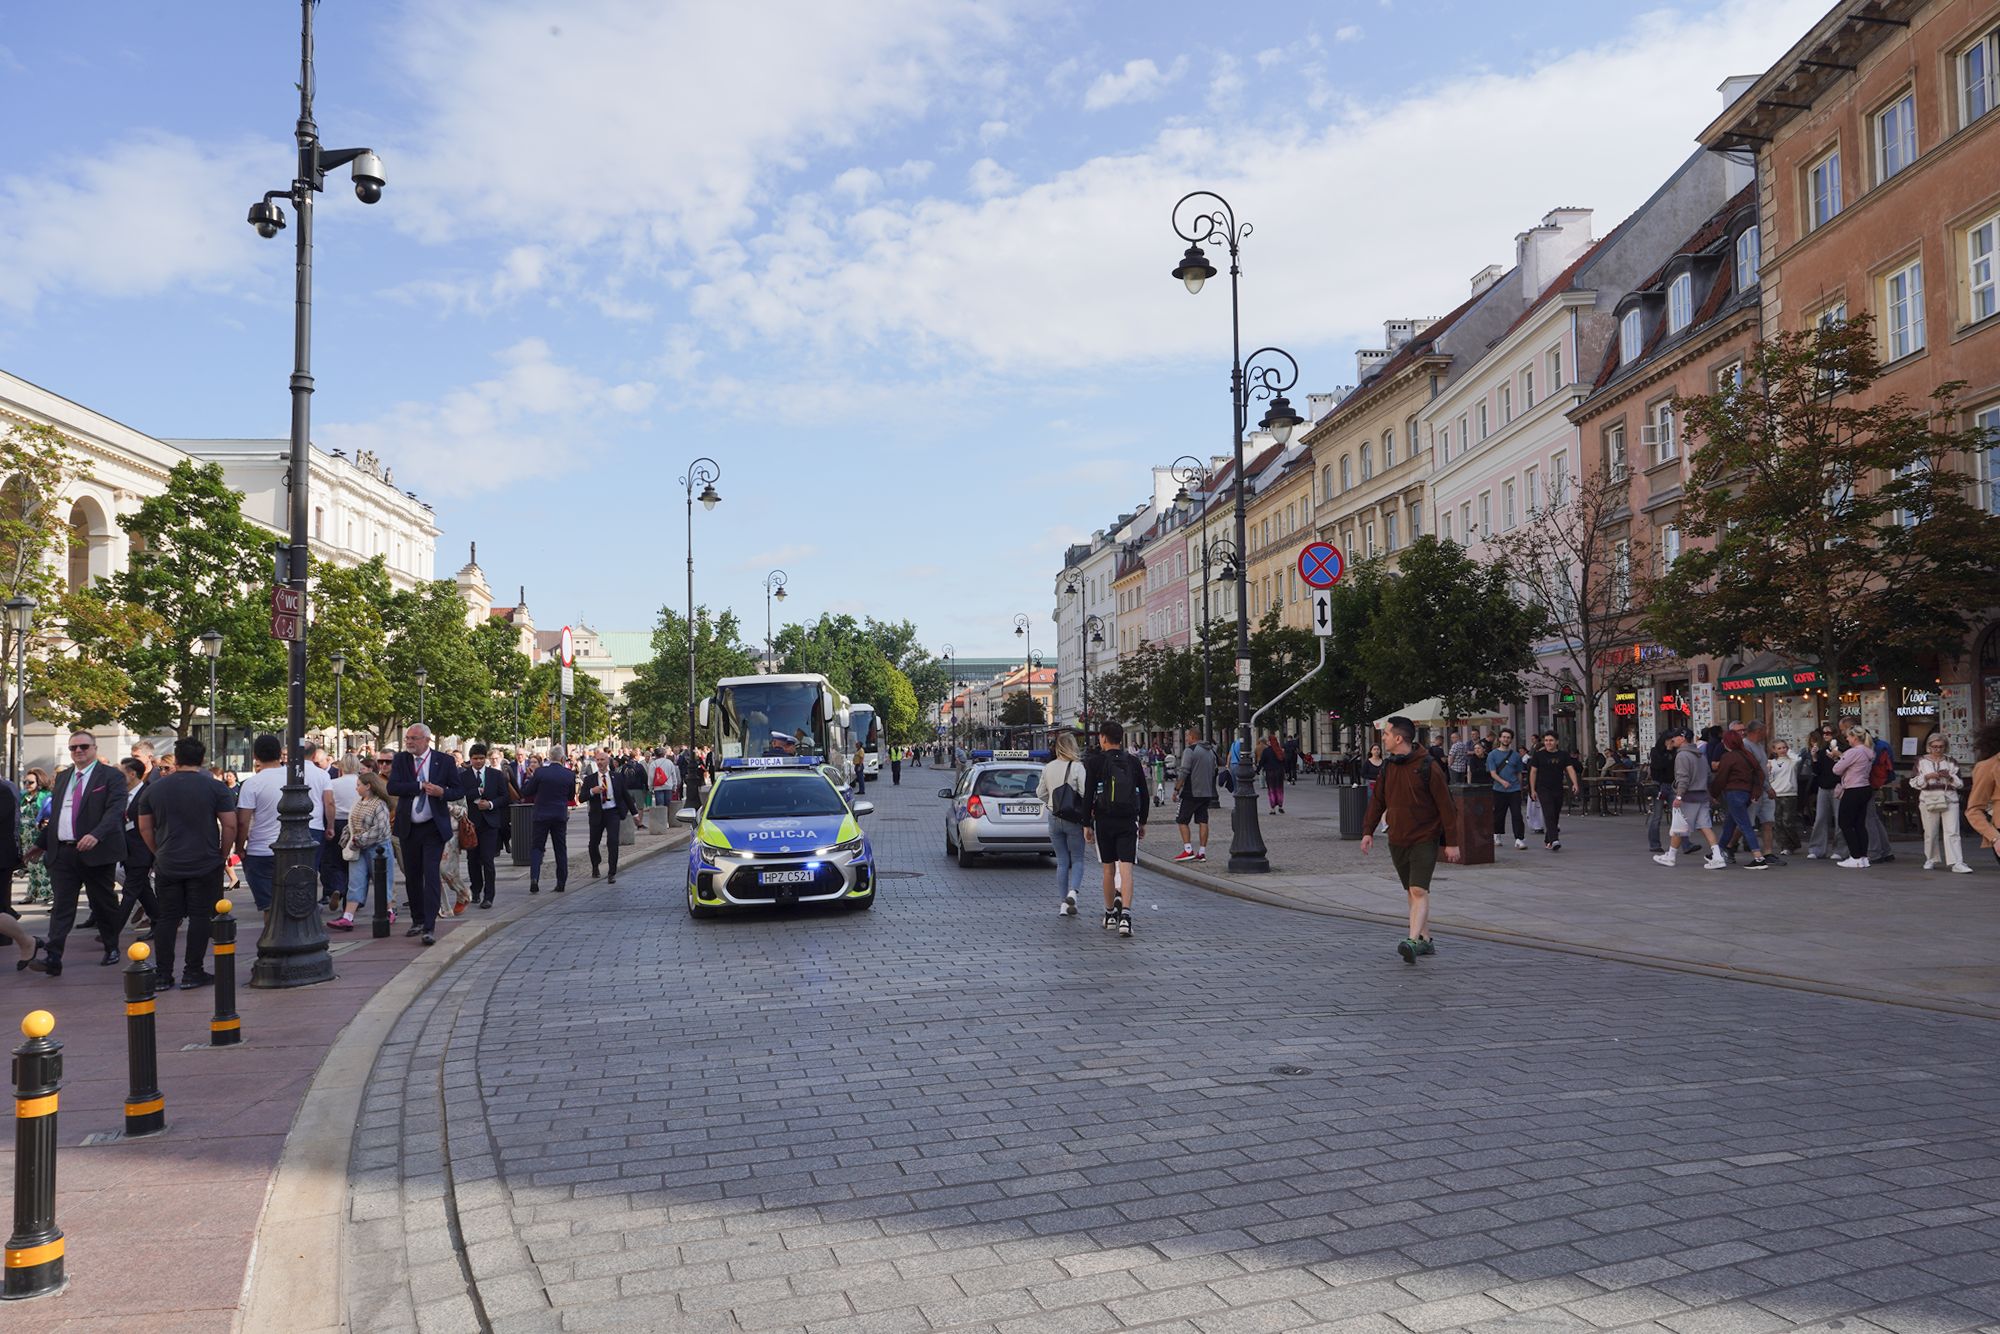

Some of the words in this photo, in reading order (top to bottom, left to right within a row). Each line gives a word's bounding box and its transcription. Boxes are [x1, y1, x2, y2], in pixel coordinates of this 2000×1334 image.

[285, 595, 298, 609] WC
[1756, 675, 1788, 688] TORTILLA
[1793, 671, 1816, 684] GOFRY
[1614, 703, 1636, 716] KEBAB
[1897, 705, 1934, 716] NATURALNE
[750, 758, 782, 766] POLICJA
[748, 830, 818, 841] POLICJA
[764, 872, 785, 883] HPZ
[787, 871, 812, 882] C521
